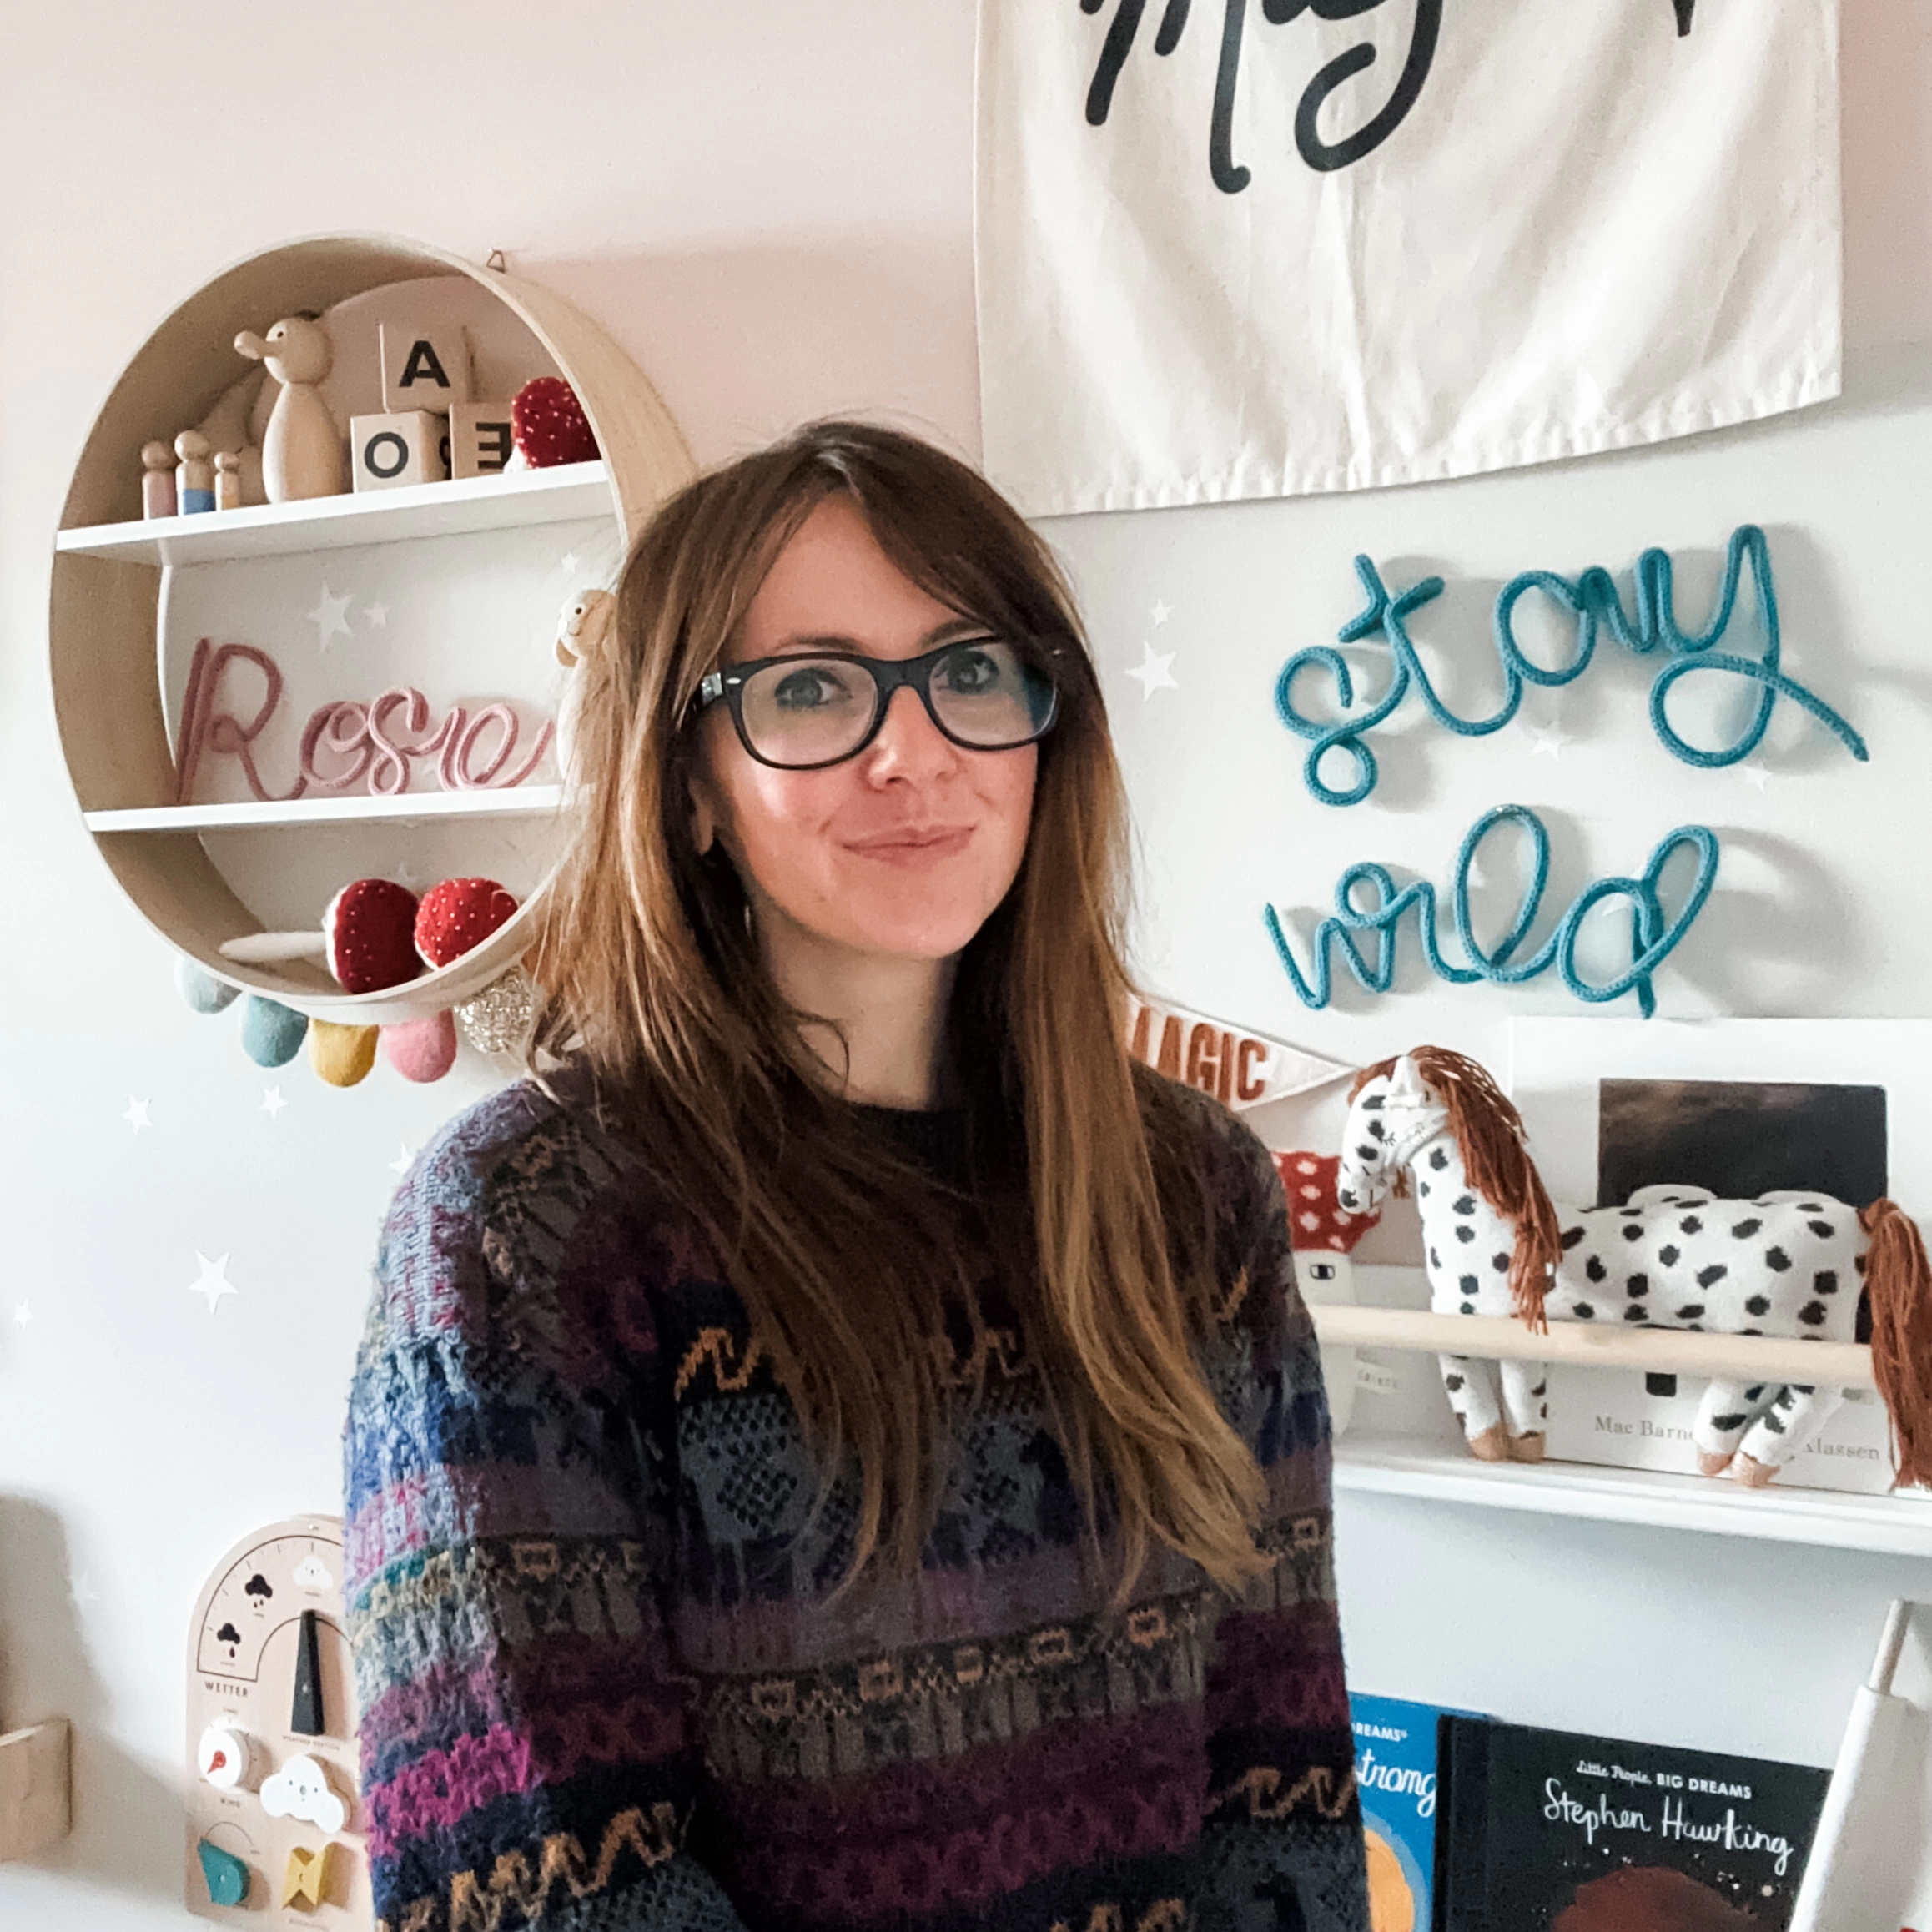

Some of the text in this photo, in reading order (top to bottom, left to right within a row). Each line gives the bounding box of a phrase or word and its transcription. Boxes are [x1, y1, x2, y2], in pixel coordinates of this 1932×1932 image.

[398, 340, 450, 388] A
[364, 430, 409, 479] O
[1275, 523, 1869, 806] stay
[1263, 803, 1720, 1019] wild
[1593, 1416, 1633, 1436] Mac
[204, 1680, 249, 1698] WETTER
[1576, 1760, 1610, 1779] Little
[1656, 1773, 1684, 1789] BIG
[1688, 1778, 1753, 1800] DREAMS
[1544, 1777, 1794, 1876] Stephen Hawking
